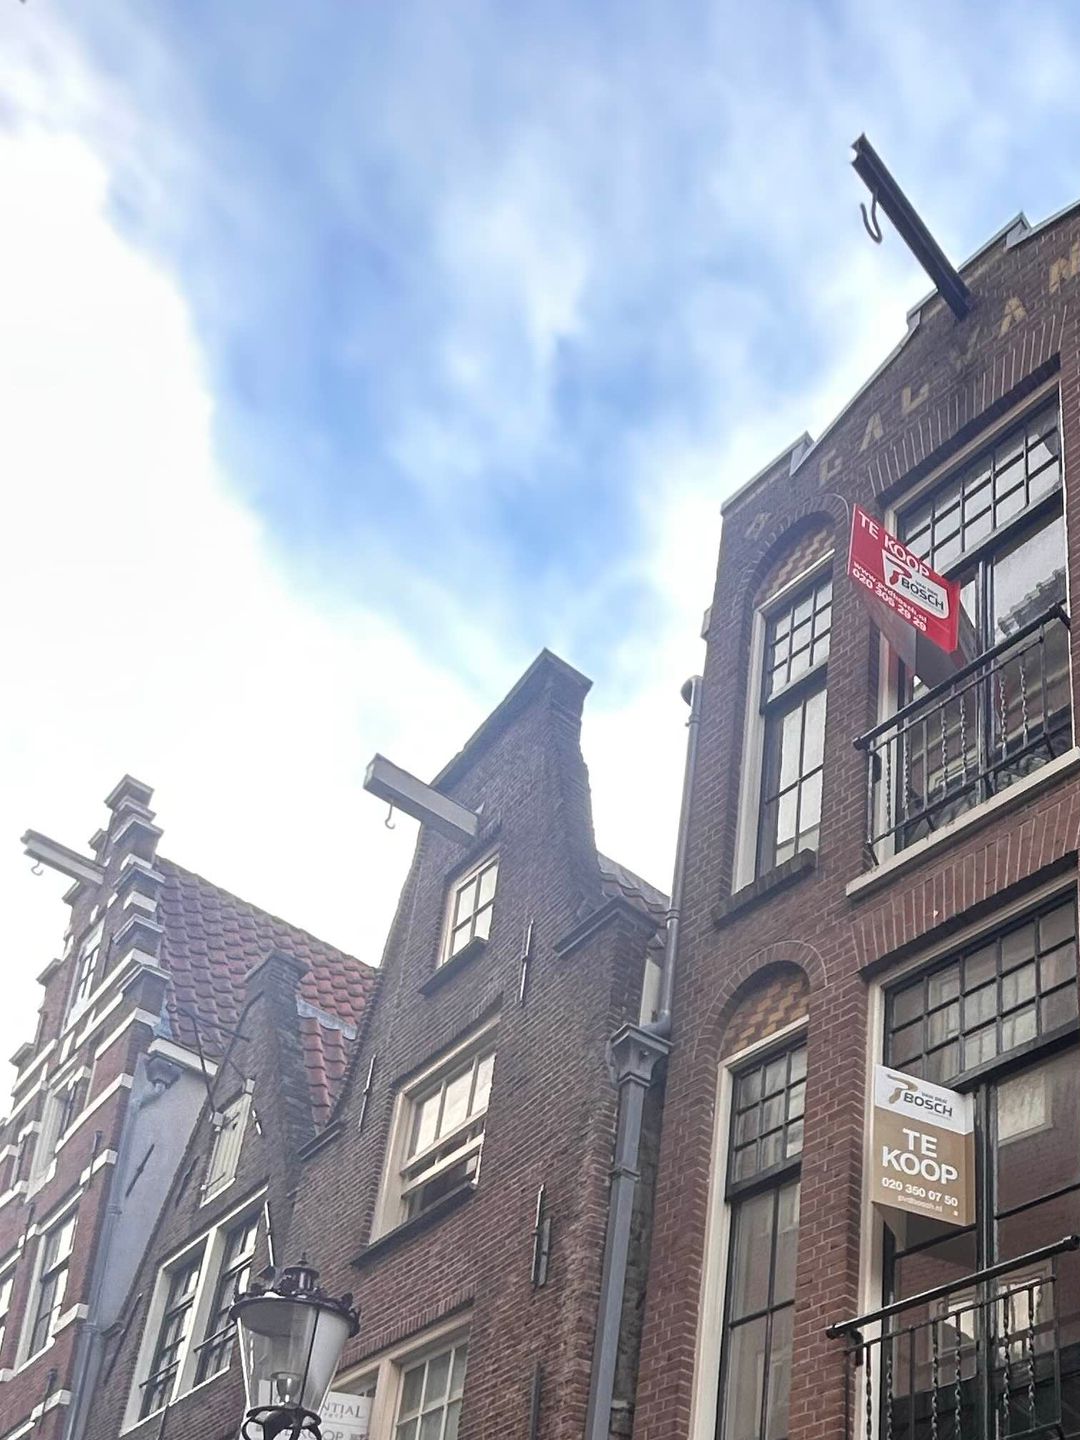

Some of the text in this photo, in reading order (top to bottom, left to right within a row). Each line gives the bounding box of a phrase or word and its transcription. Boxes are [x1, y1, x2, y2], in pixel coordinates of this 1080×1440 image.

[858, 511, 930, 577] TE KOOP
[852, 568, 873, 590] 020
[901, 577, 944, 611] BOSCH
[903, 1092, 953, 1117] BOSCH
[903, 1128, 937, 1158] TE
[882, 1146, 958, 1185] KOOP
[882, 1177, 958, 1207] 020 350 07 50
